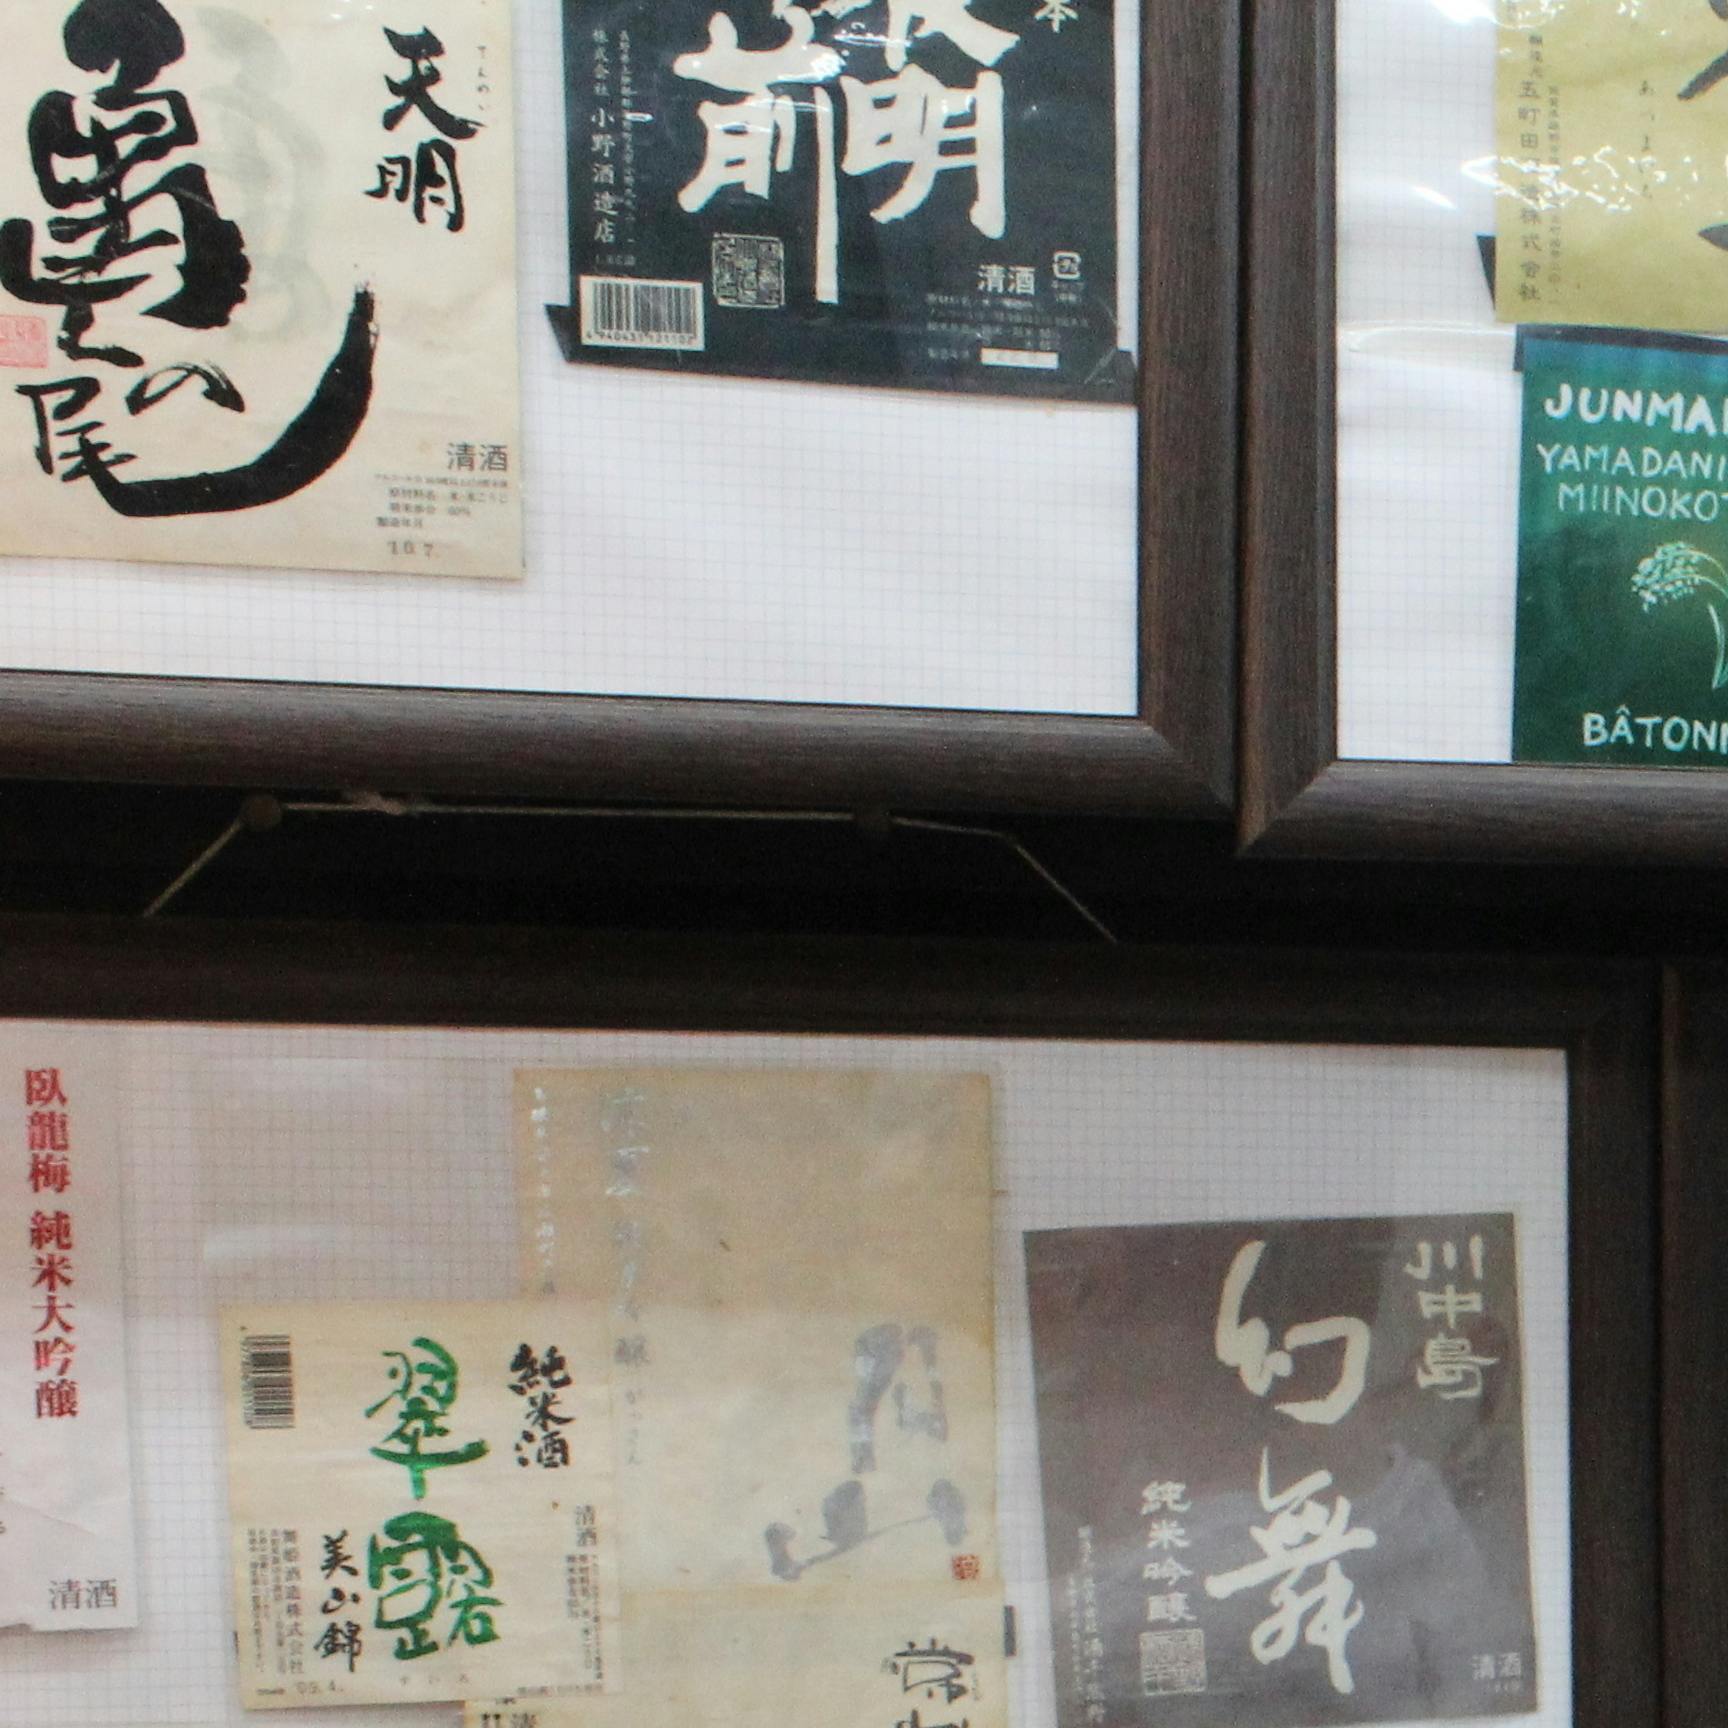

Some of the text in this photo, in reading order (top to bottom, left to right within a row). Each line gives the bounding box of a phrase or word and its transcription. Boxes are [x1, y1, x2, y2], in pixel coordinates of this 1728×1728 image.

[364, 26, 487, 232] 天明
[977, 263, 1037, 296] 清酒
[446, 441, 508, 471] 清酒
[30, 1209, 79, 1420] 純米大吟醸
[1404, 1233, 1499, 1400] 川中島
[508, 1343, 577, 1470] 純米酒
[1204, 1239, 1378, 1695] 幻舞
[48, 1577, 119, 1612] 清酒
[313, 1528, 365, 1673] 美山錦
[1138, 1479, 1198, 1624] 純米吟醸
[1471, 1652, 1522, 1682] 清酒
